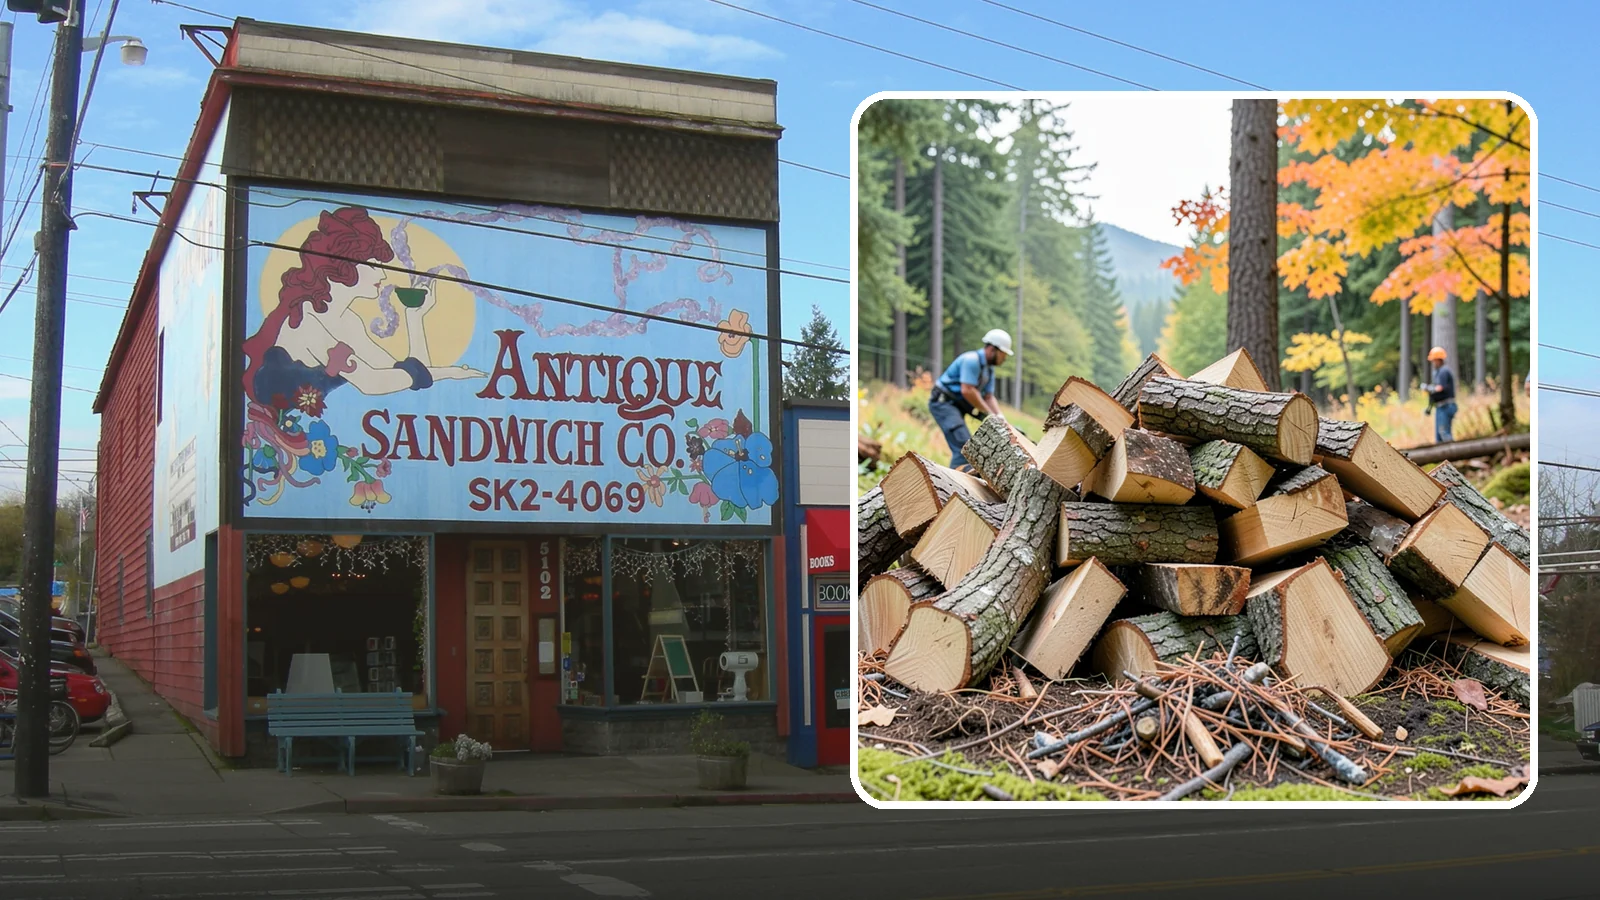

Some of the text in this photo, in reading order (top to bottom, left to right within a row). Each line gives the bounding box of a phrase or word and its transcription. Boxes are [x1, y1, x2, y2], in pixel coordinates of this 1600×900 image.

[476, 329, 722, 421] ANTIQUE
[361, 409, 685, 469] SANDWICH CO.
[468, 476, 646, 513] SK2-4069
[539, 541, 552, 600] 5102
[809, 555, 835, 569] BOOKS
